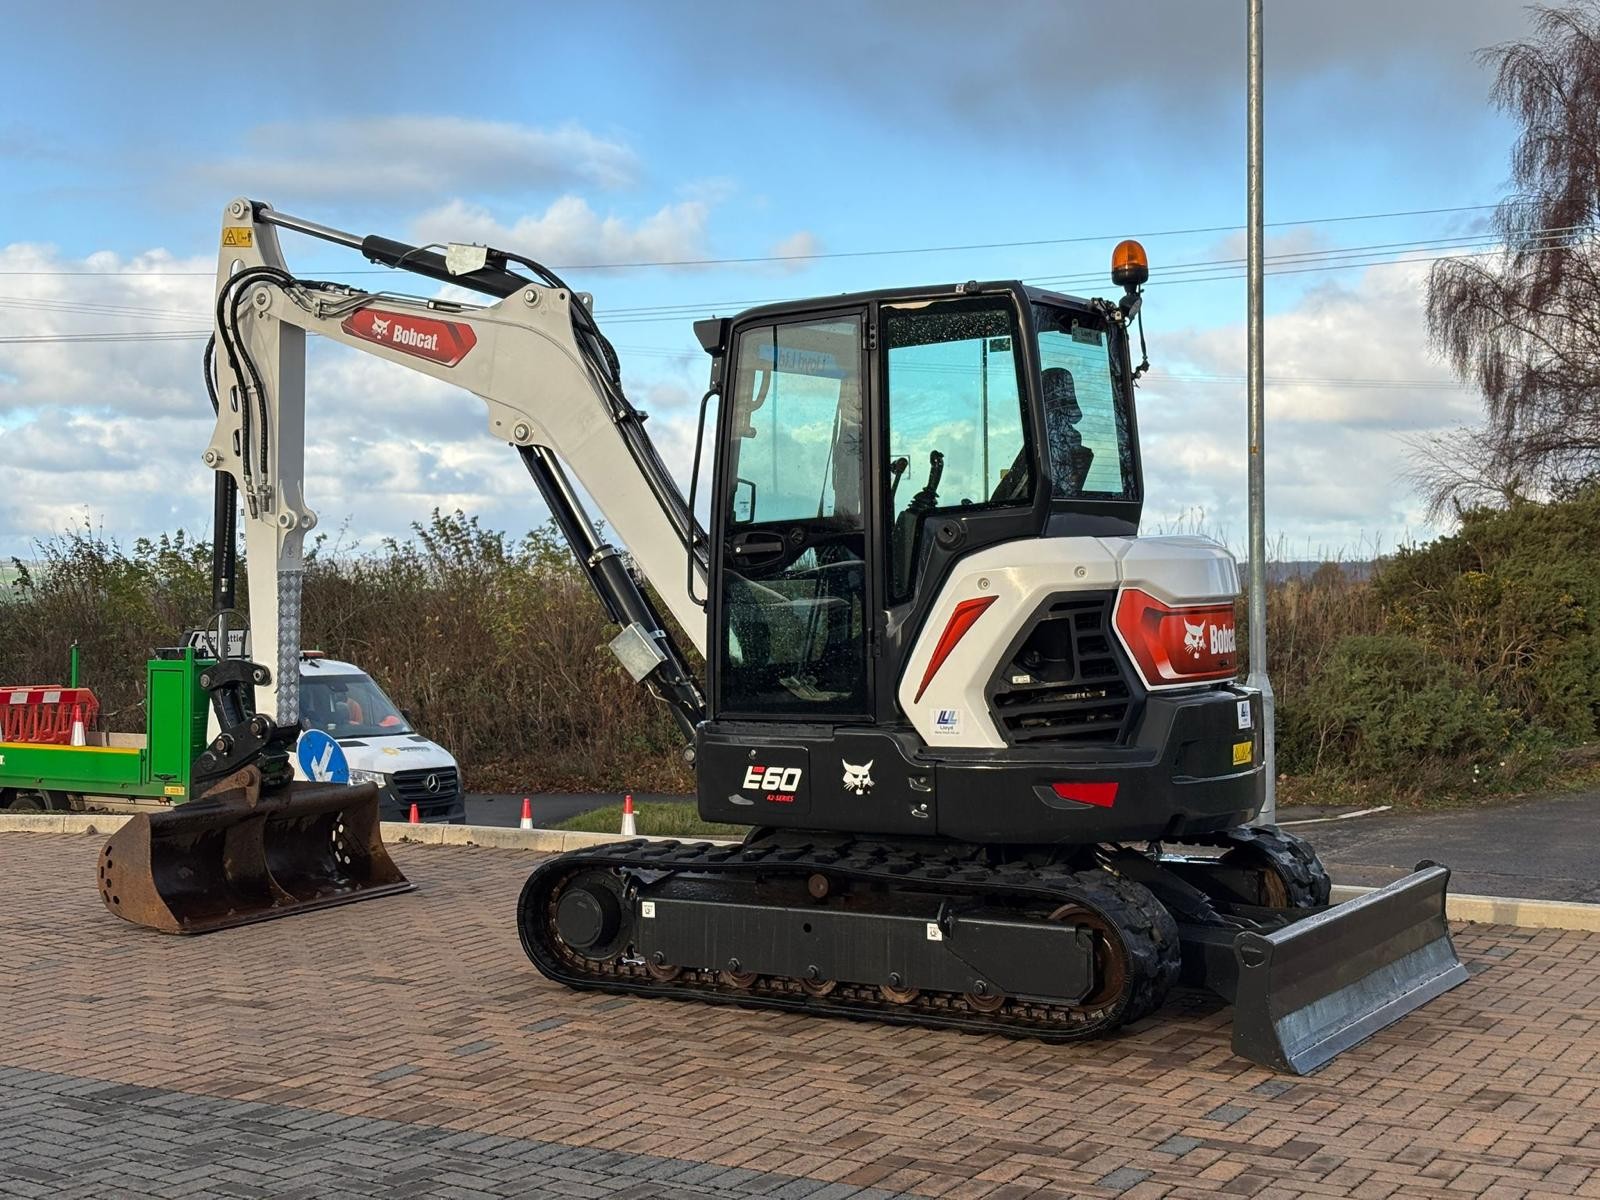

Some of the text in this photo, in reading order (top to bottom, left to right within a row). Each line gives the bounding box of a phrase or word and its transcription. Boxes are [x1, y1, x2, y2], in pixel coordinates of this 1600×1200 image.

[393, 324, 438, 351] Bobcat
[1210, 623, 1236, 655] Bobca
[743, 765, 802, 792] E60
